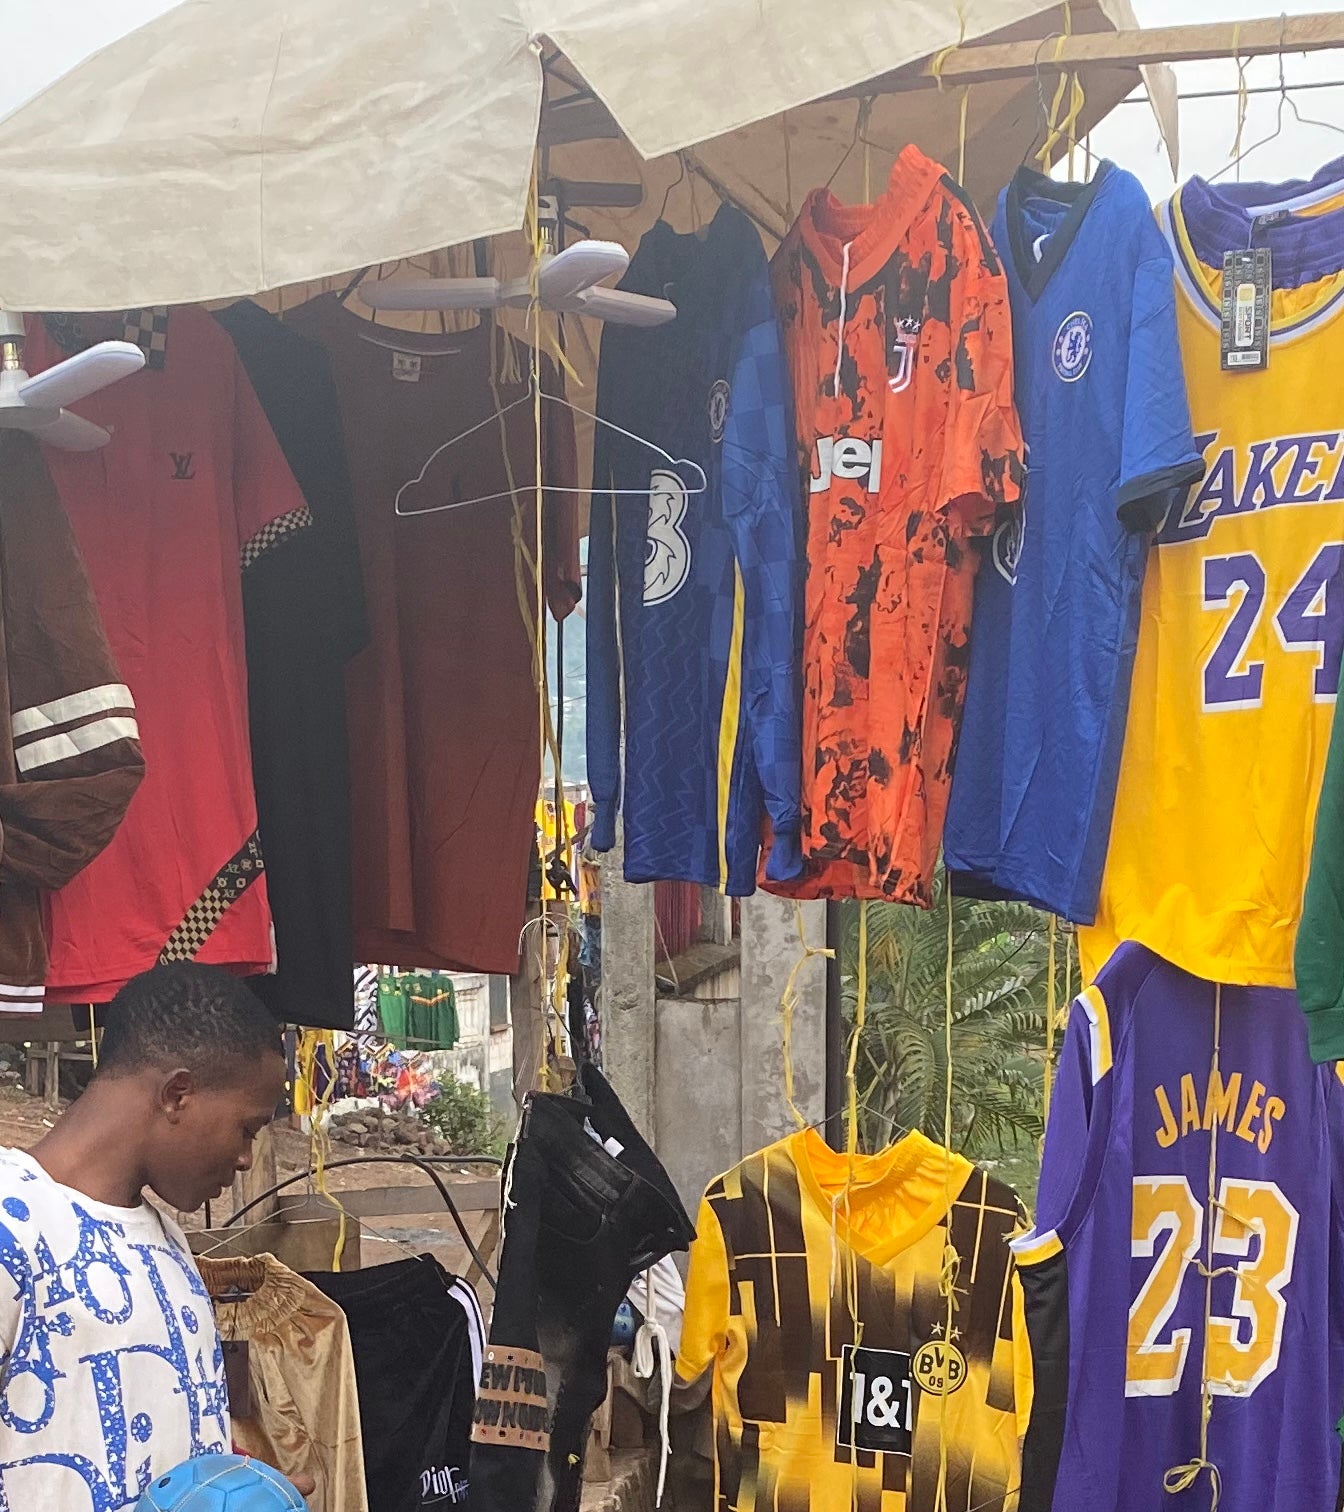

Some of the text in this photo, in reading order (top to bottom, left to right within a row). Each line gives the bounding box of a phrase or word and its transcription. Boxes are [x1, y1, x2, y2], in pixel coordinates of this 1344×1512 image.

[1154, 1071, 1286, 1154] JAMES
[1124, 1175, 1301, 1398] 23
[918, 1346, 961, 1381] BVB
[419, 1465, 460, 1504] Dior
